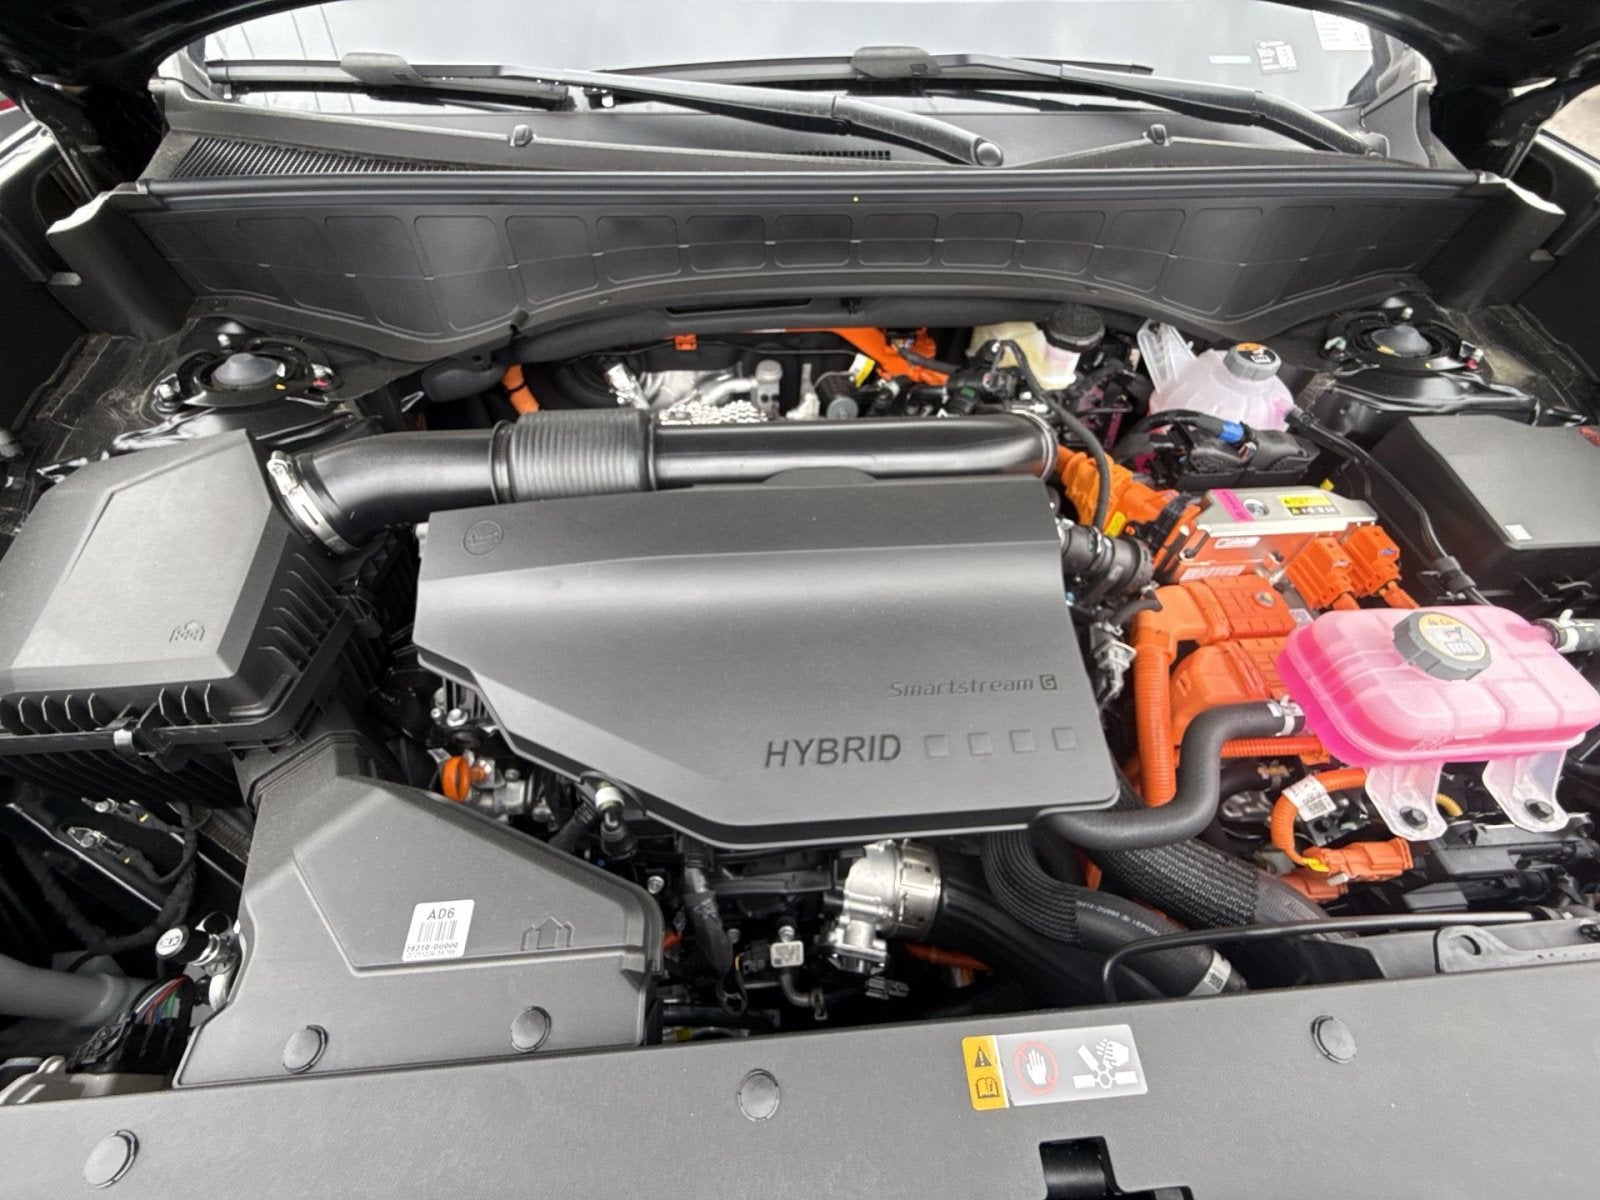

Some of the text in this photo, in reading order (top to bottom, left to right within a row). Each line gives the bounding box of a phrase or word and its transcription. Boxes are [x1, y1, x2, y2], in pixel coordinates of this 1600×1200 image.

[889, 677, 1034, 698] Smartstream
[764, 734, 902, 768] HYBRID
[427, 908, 455, 920] AD6
